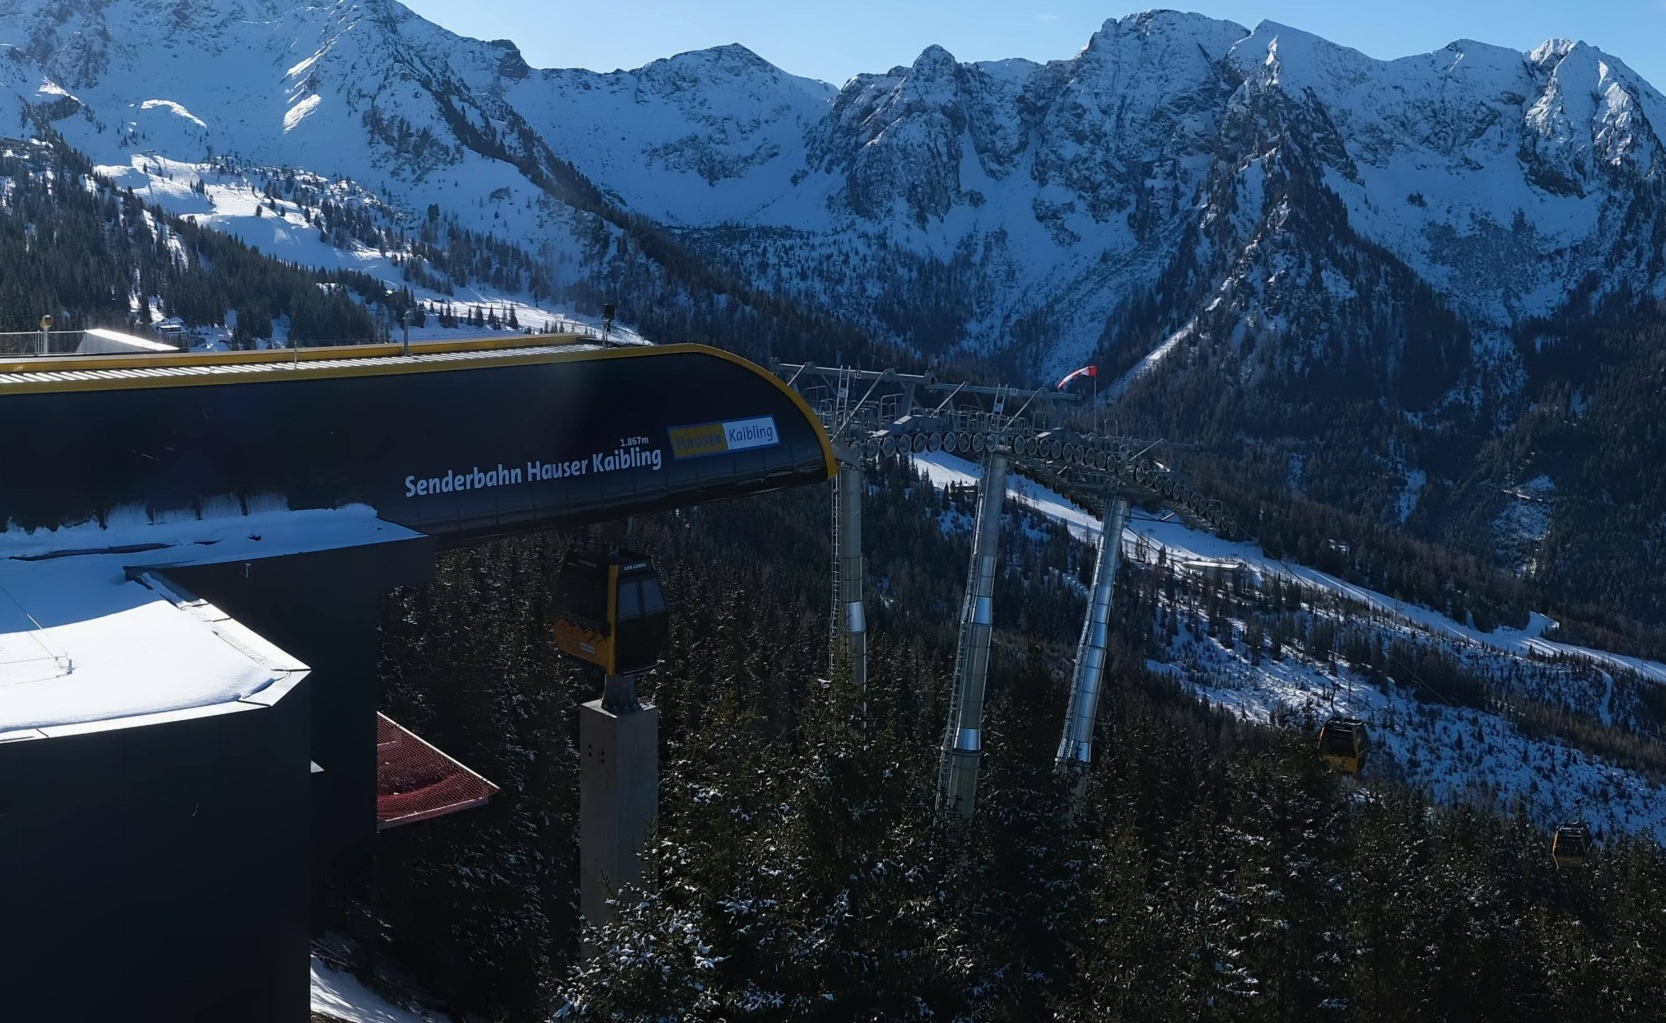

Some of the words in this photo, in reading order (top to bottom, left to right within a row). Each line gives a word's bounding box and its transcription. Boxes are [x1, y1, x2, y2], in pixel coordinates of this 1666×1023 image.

[620, 435, 650, 447] 1.867m
[676, 433, 722, 449] HAUSER
[729, 425, 773, 442] Kaibling
[404, 463, 522, 498] Senderbahn
[526, 458, 588, 482] Hauser
[592, 446, 662, 474] Kaibling
